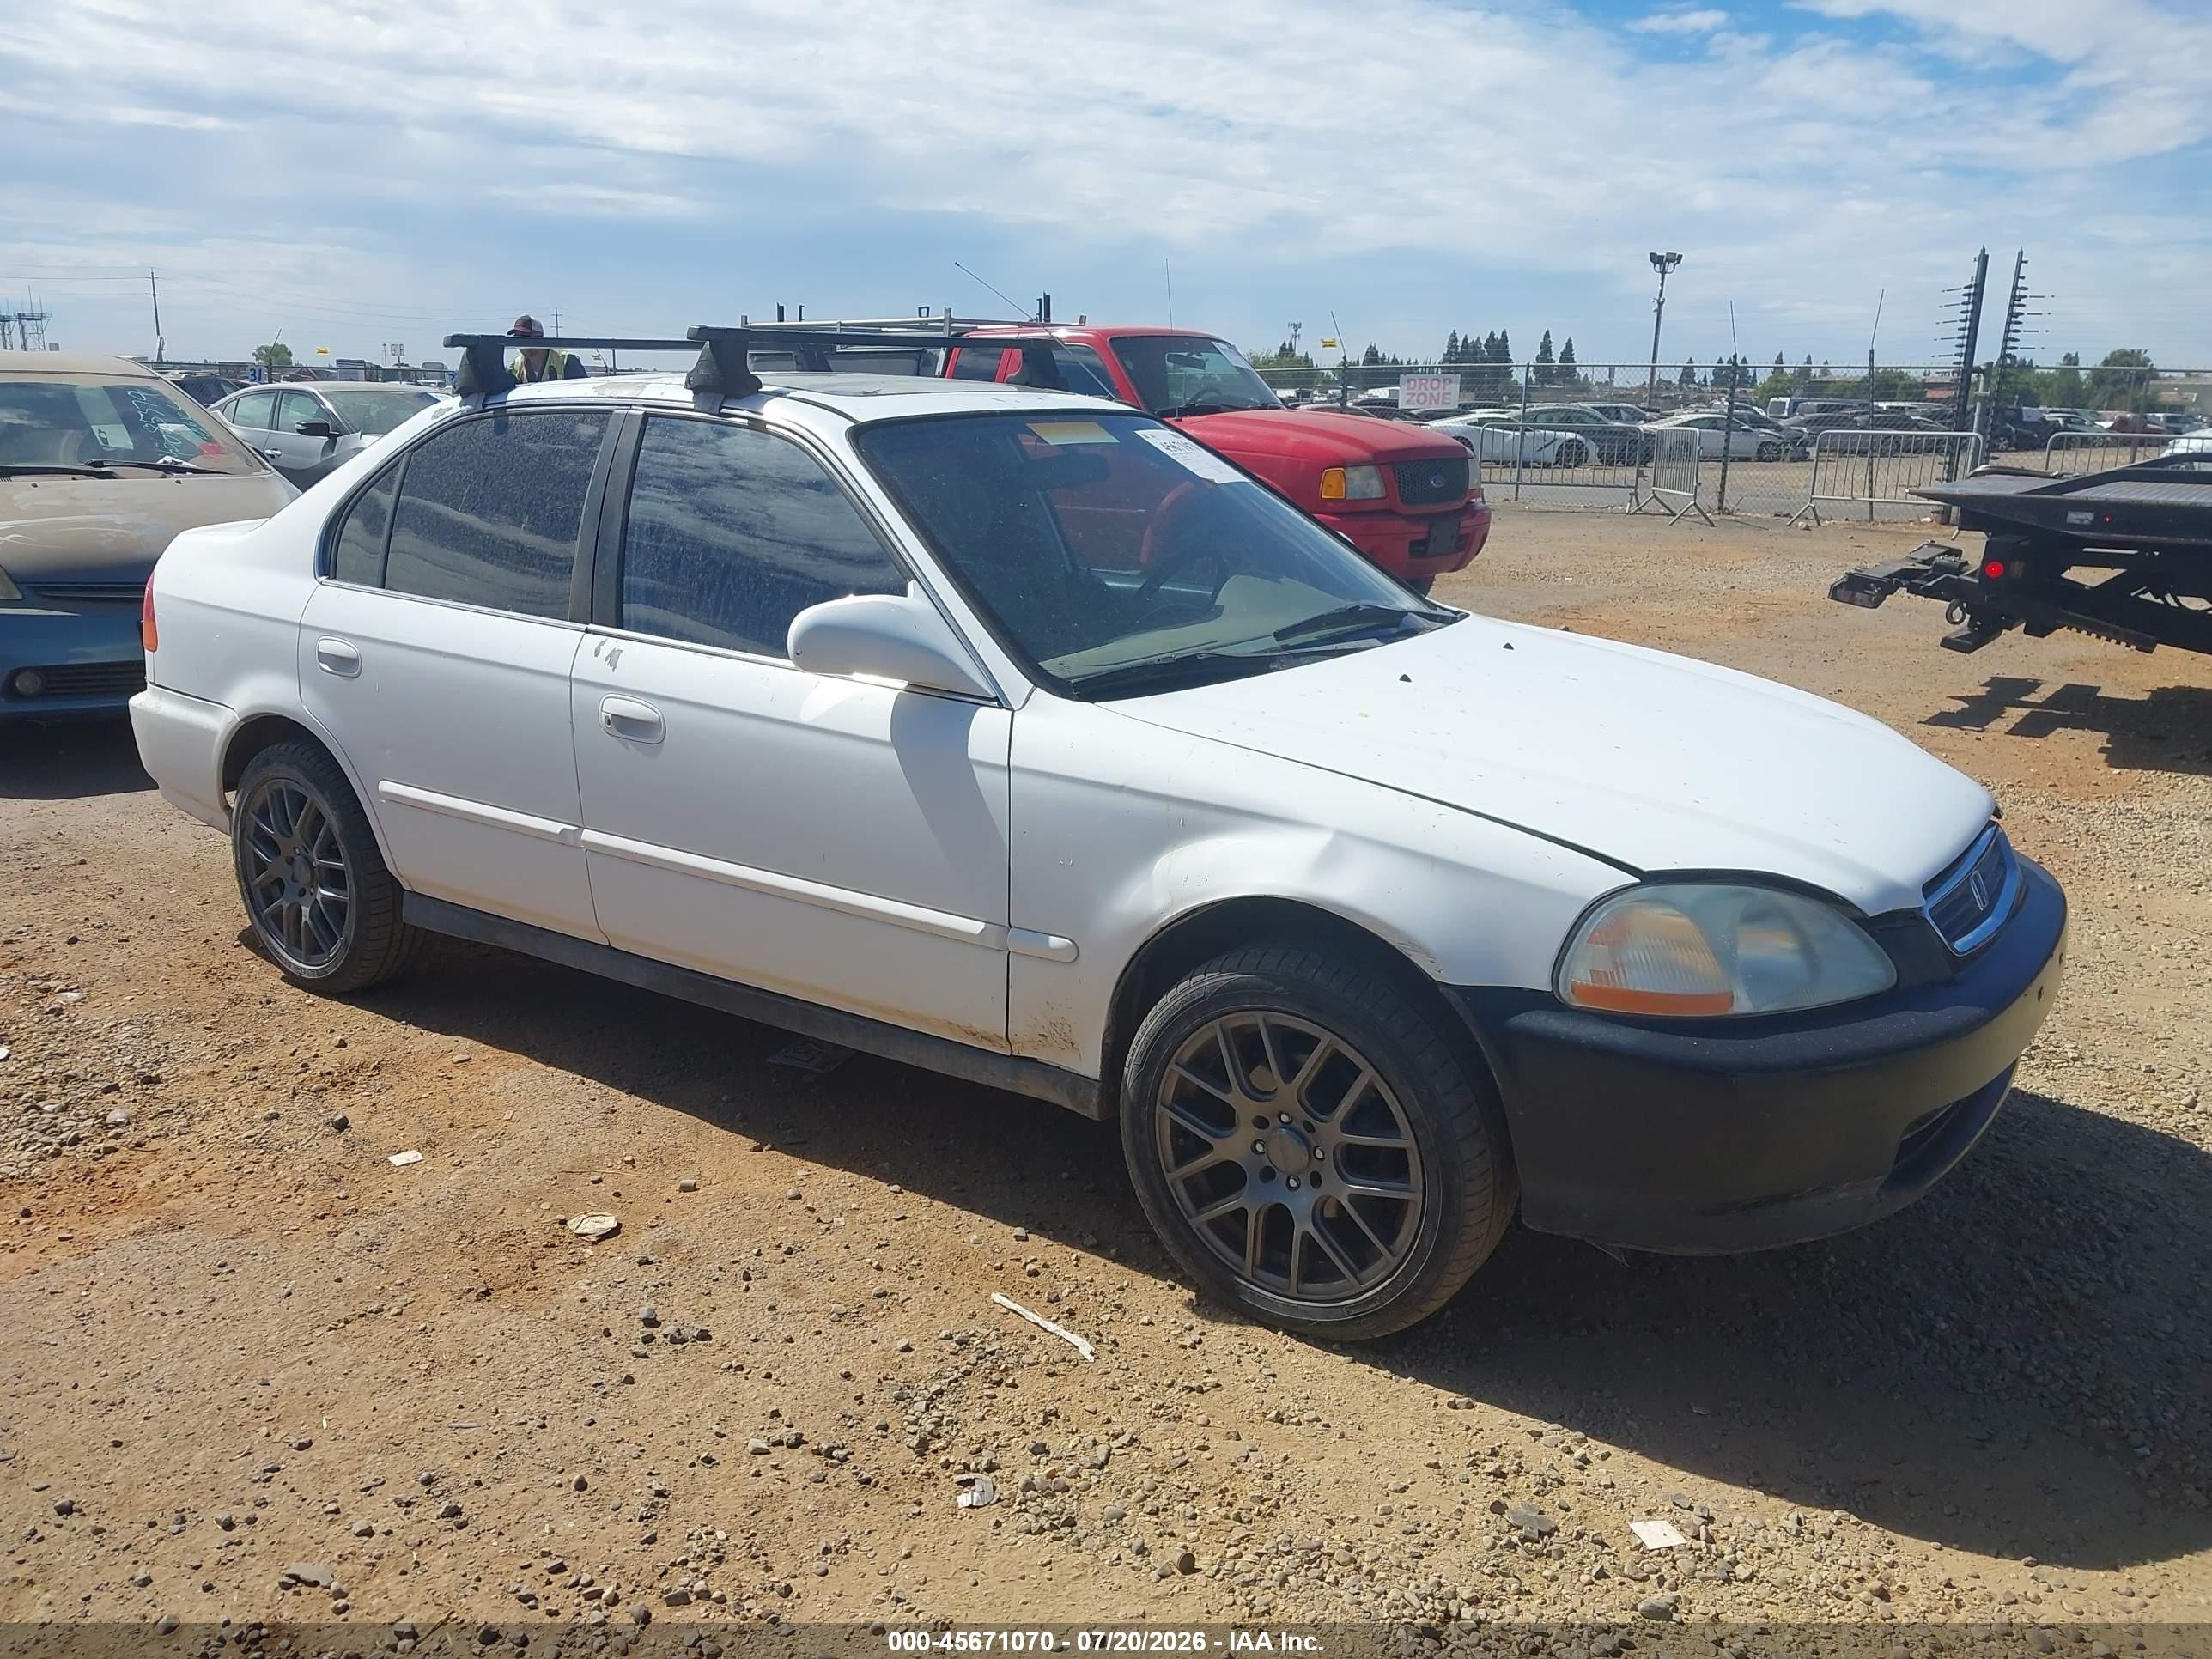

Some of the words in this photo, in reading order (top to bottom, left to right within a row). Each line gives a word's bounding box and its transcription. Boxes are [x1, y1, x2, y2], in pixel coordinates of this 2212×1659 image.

[247, 366, 262, 382] 31
[1407, 378, 1453, 391] DROP
[1406, 392, 1451, 405] ZONE
